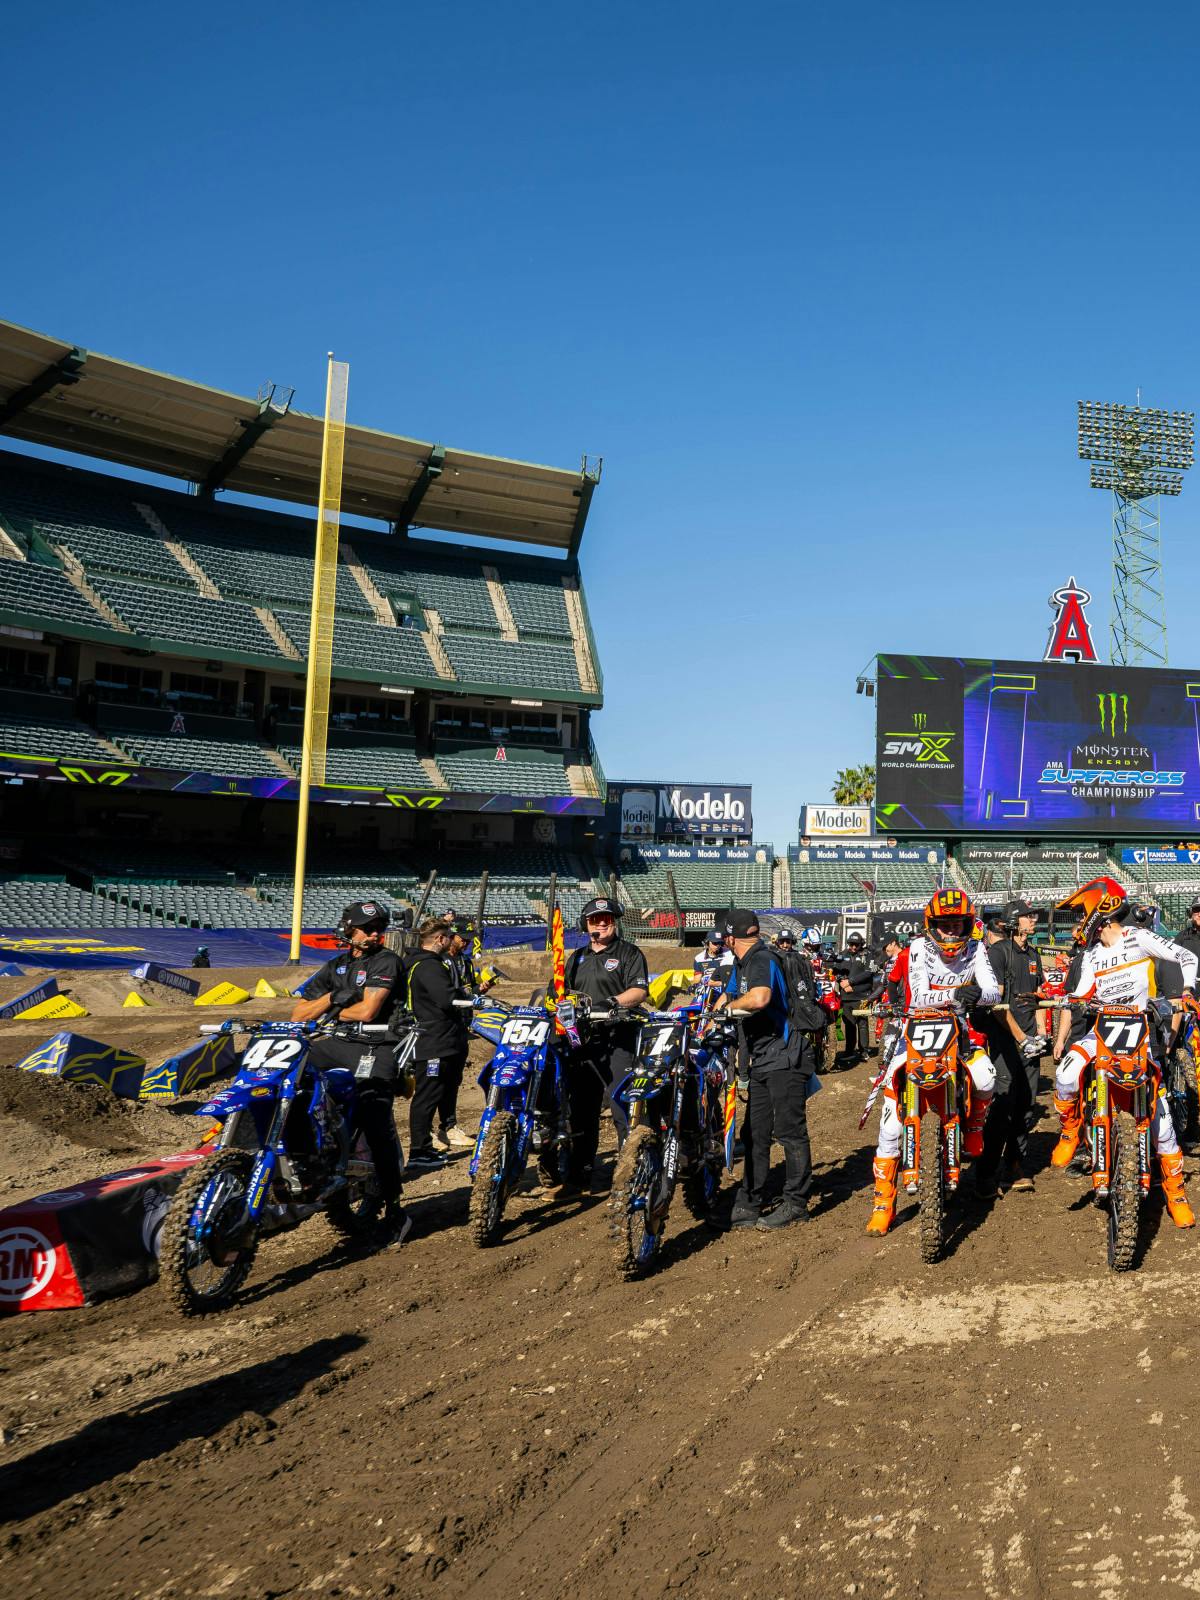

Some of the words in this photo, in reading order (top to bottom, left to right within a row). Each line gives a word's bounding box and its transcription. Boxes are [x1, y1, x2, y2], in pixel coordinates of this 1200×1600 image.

[883, 737, 951, 762] SMX
[1076, 744, 1150, 757] MONSTER
[1046, 761, 1063, 769] AMA
[1088, 758, 1139, 766] ENERGY
[1038, 769, 1186, 785] SUPERCROSS
[1071, 787, 1155, 798] CHAMPIONSHIP
[658, 789, 745, 820] Modelo
[623, 808, 654, 823] Modelo
[815, 810, 862, 828] Modelo
[668, 849, 690, 858] Modelo
[697, 849, 720, 858] Modelo
[727, 849, 749, 858] Modelo
[817, 850, 838, 859] Modelo
[844, 850, 865, 859] Modelo
[872, 850, 892, 859] Modelo
[899, 850, 919, 859] Modelo
[1042, 851, 1064, 859] NITTO
[166, 974, 191, 991] YAMAHA
[14, 988, 46, 1016] YAMAHA
[501, 1020, 549, 1046] 154
[912, 1024, 953, 1051] 57
[1104, 1022, 1143, 1047] 71
[650, 1027, 674, 1056] 1
[242, 1039, 302, 1069] 42
